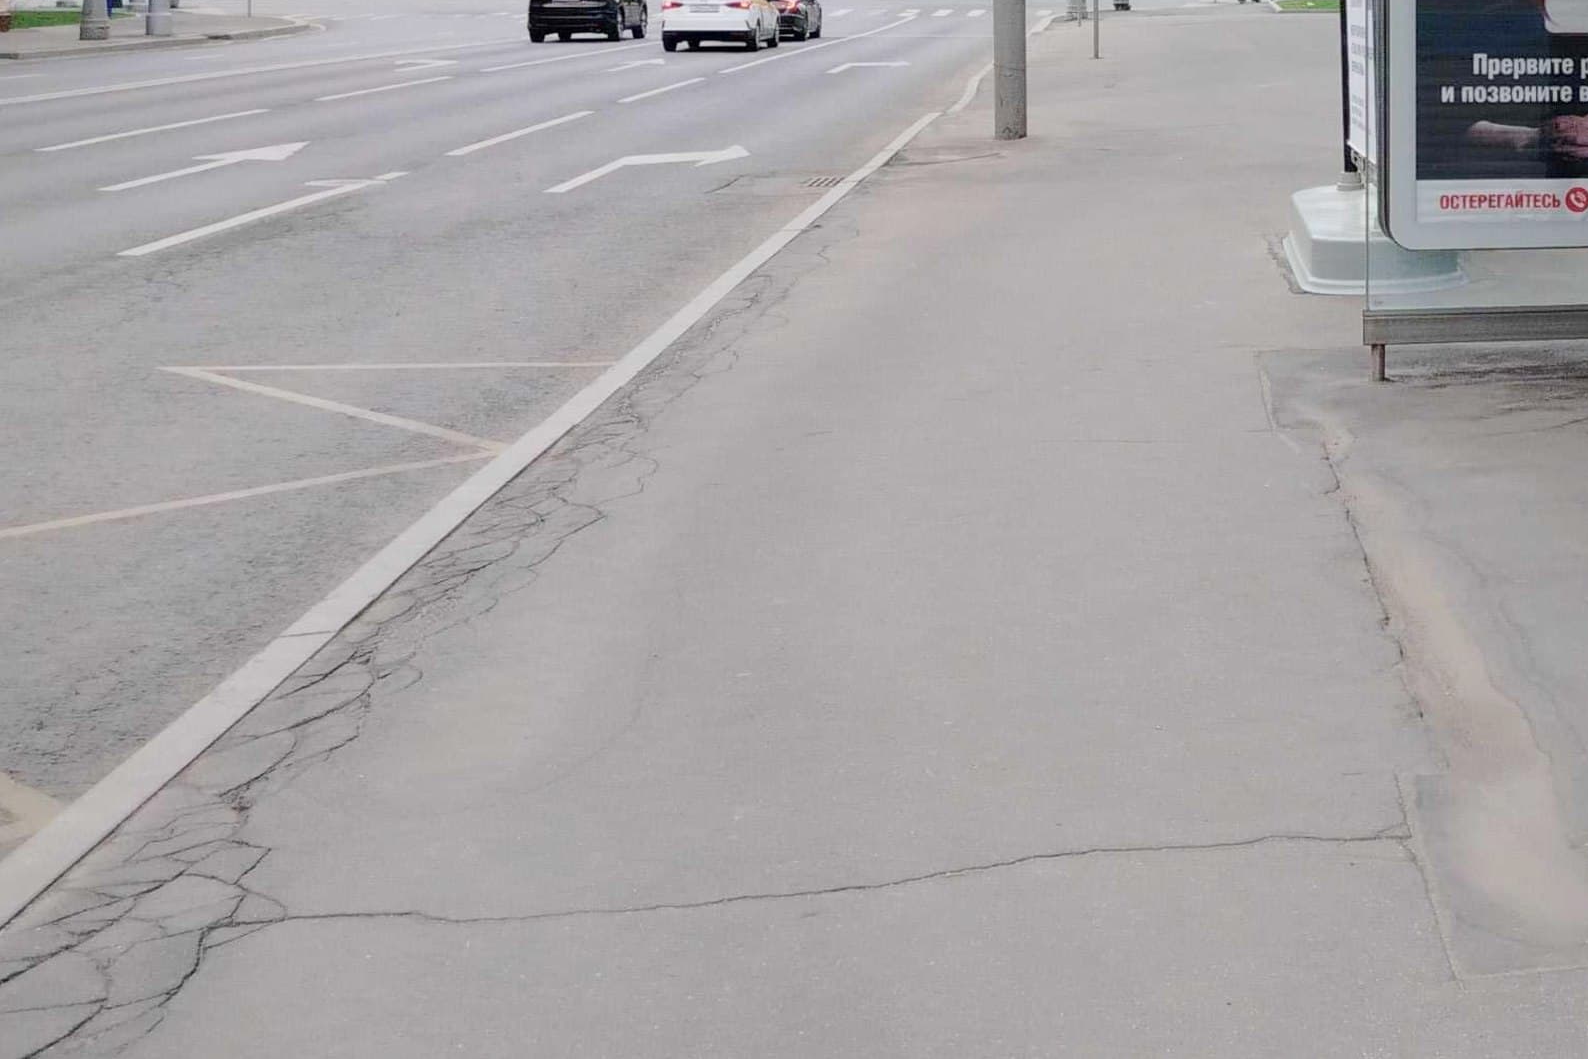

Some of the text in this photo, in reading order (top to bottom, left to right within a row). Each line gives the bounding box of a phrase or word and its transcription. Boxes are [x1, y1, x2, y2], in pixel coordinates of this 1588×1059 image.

[1472, 53, 1574, 79] Прервите
[1441, 87, 1455, 103] и
[1461, 84, 1572, 103] позвоните
[1439, 190, 1560, 210] ОСТЕРЕГАЙТЕСЬ
